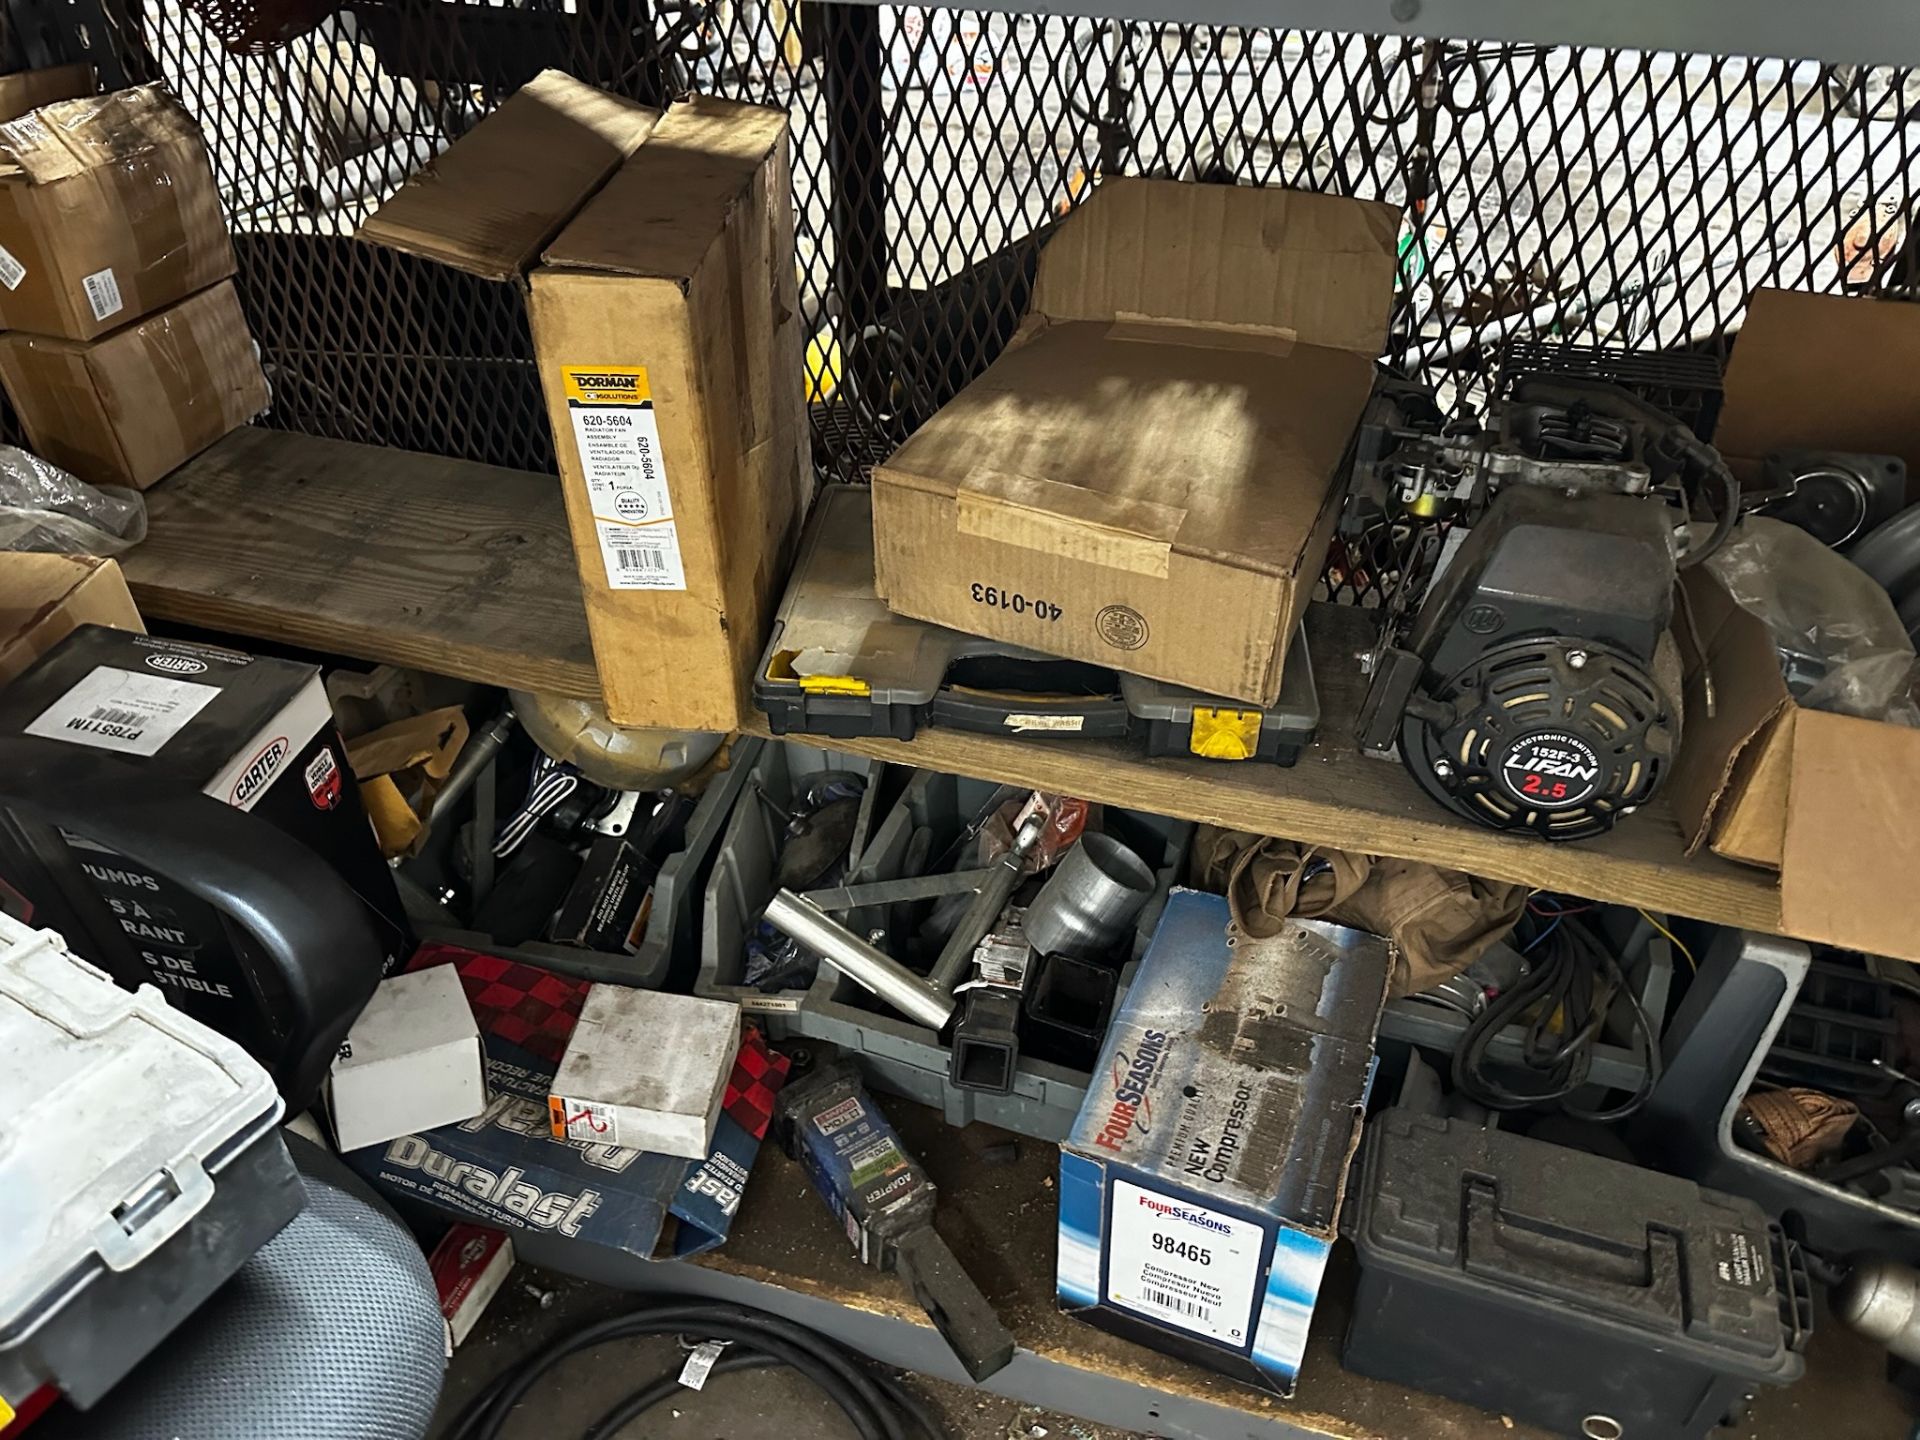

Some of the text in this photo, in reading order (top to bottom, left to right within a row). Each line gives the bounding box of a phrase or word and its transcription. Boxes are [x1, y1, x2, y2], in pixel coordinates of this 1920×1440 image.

[573, 376, 639, 388] DORMAN
[583, 416, 632, 427] 620-5604
[637, 436, 655, 480] 620-5604
[971, 583, 1062, 622] 40-0193
[153, 656, 200, 672] CARTER
[66, 717, 144, 741] P76511M
[1511, 734, 1599, 767] ELECTRONIC IGNITION
[1531, 746, 1581, 763] 152F-3
[236, 743, 282, 801] CARTER
[310, 759, 329, 781] VEHICLE
[1504, 753, 1599, 781] LIFAN
[1522, 774, 1567, 798] 2.5
[163, 955, 198, 975] DE
[823, 1115, 848, 1132] TOW
[1202, 1080, 1253, 1183] Compressor
[1166, 1123, 1191, 1168] PREMIUM
[1184, 1137, 1211, 1177] NEW
[378, 1171, 417, 1189] MOTOR
[418, 1184, 434, 1195] DE
[383, 1134, 603, 1238] Duralast
[703, 1162, 736, 1186] STARTER
[865, 1172, 912, 1204] ADAPTER
[432, 1181, 525, 1228] REMANUFACTURED
[1139, 1196, 1231, 1234] FOURSEASONS
[1152, 1233, 1212, 1266] 98465
[1140, 1275, 1222, 1308] Compresseur Neuf
[1143, 1269, 1221, 1301] Compresor Nuevo
[1144, 1262, 1220, 1293] Compressor New
